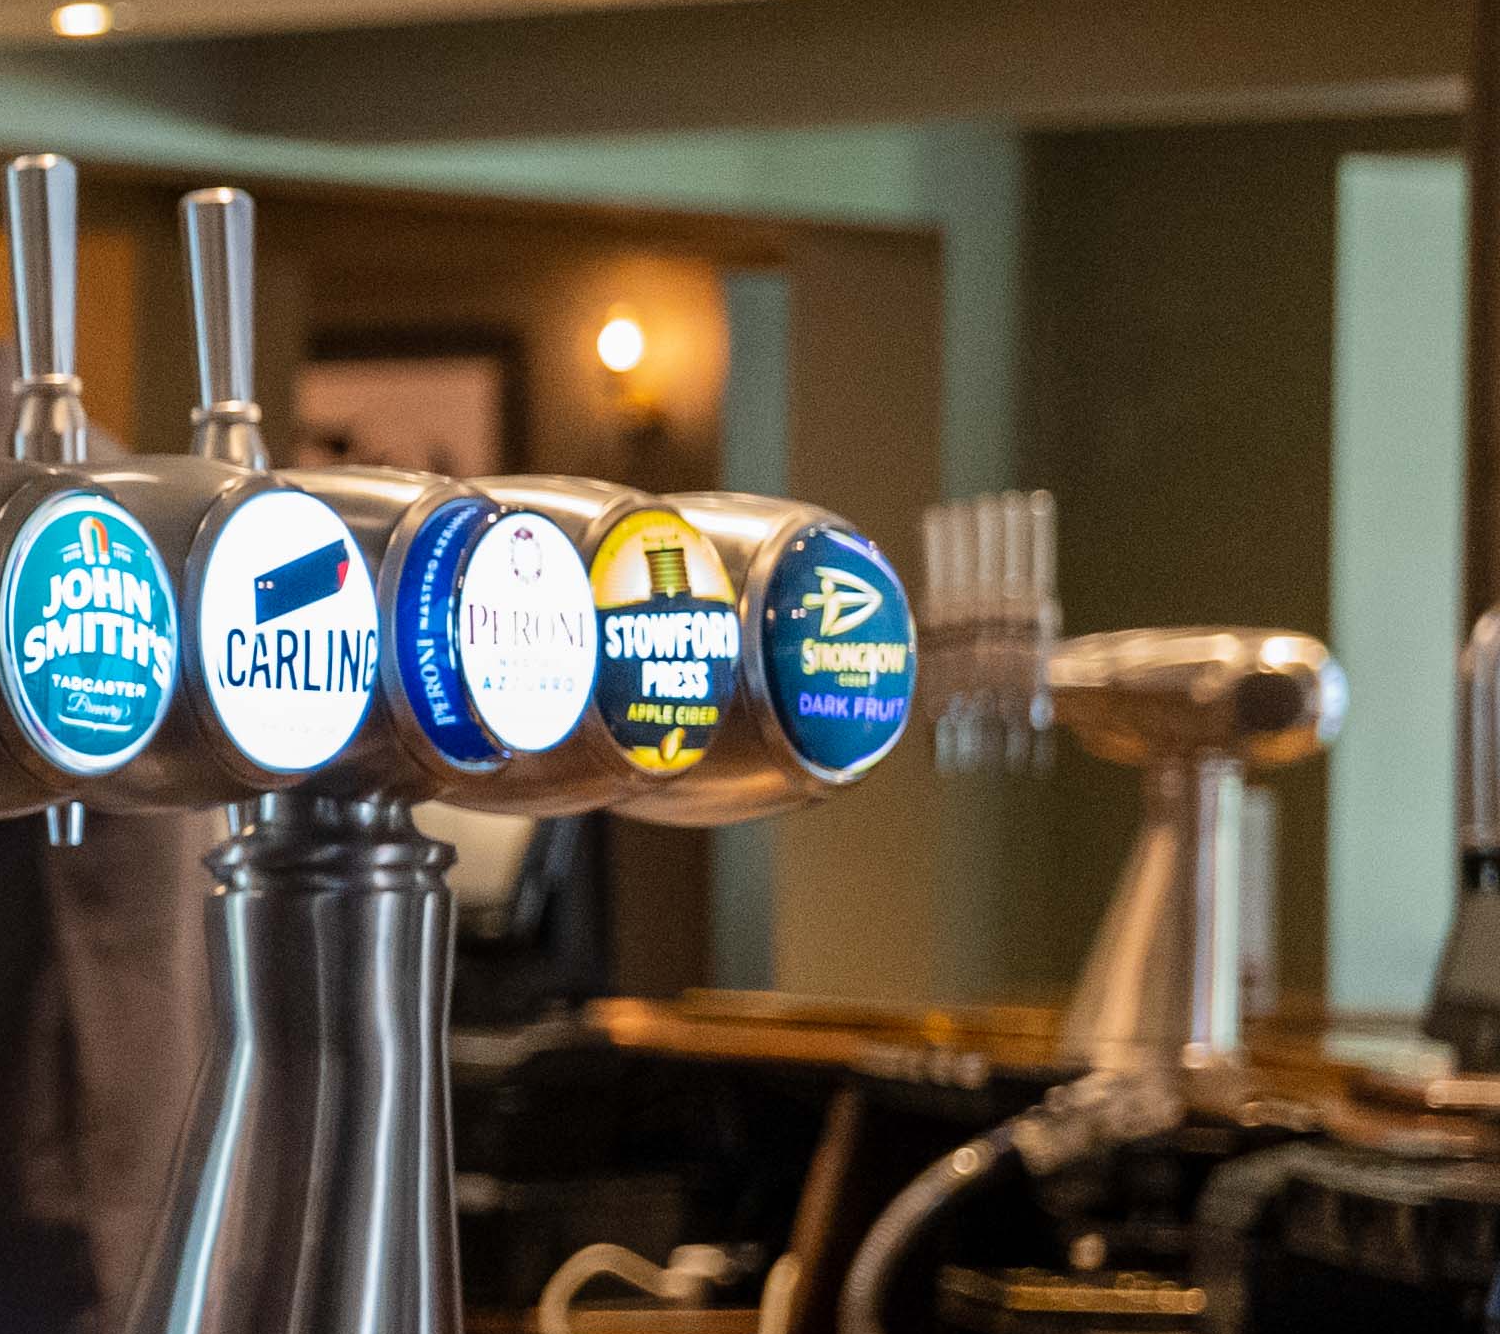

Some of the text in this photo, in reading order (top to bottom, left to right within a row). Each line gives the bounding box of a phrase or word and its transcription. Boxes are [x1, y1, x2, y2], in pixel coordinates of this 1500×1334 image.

[42, 566, 153, 622] JOHN
[23, 611, 174, 690] SMITH'S
[227, 627, 378, 693] CARLING
[802, 637, 907, 676] STRONGBOW
[51, 673, 147, 698] TADCASTER
[418, 638, 458, 726] PERONI
[641, 660, 709, 699] PRESS
[626, 703, 719, 726] APPLE CIDER
[799, 692, 907, 721] DARK FRUIT
